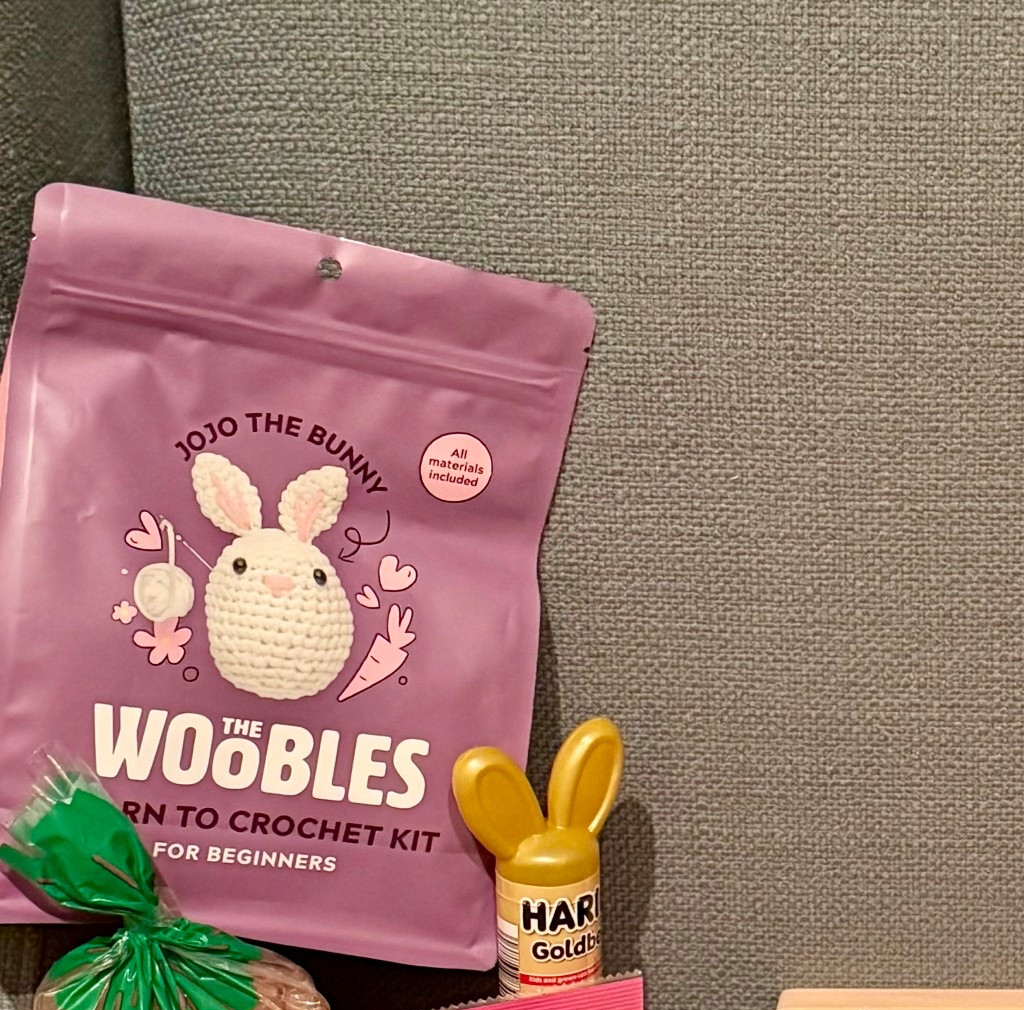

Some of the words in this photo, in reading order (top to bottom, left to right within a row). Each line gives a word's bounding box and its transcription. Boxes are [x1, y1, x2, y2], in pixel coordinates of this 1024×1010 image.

[174, 416, 239, 462] JOJO
[245, 412, 303, 438] THE
[307, 424, 388, 494] BUNNY
[451, 449, 468, 460] All
[428, 458, 485, 476] materials
[428, 470, 479, 488] included
[222, 717, 264, 739] THE
[94, 702, 431, 809] WOOBLES
[176, 805, 219, 830] TO
[228, 810, 383, 846] CROCHET
[388, 828, 441, 854] KIT
[152, 842, 200, 861] FOR
[206, 846, 338, 872] BEGINNERS
